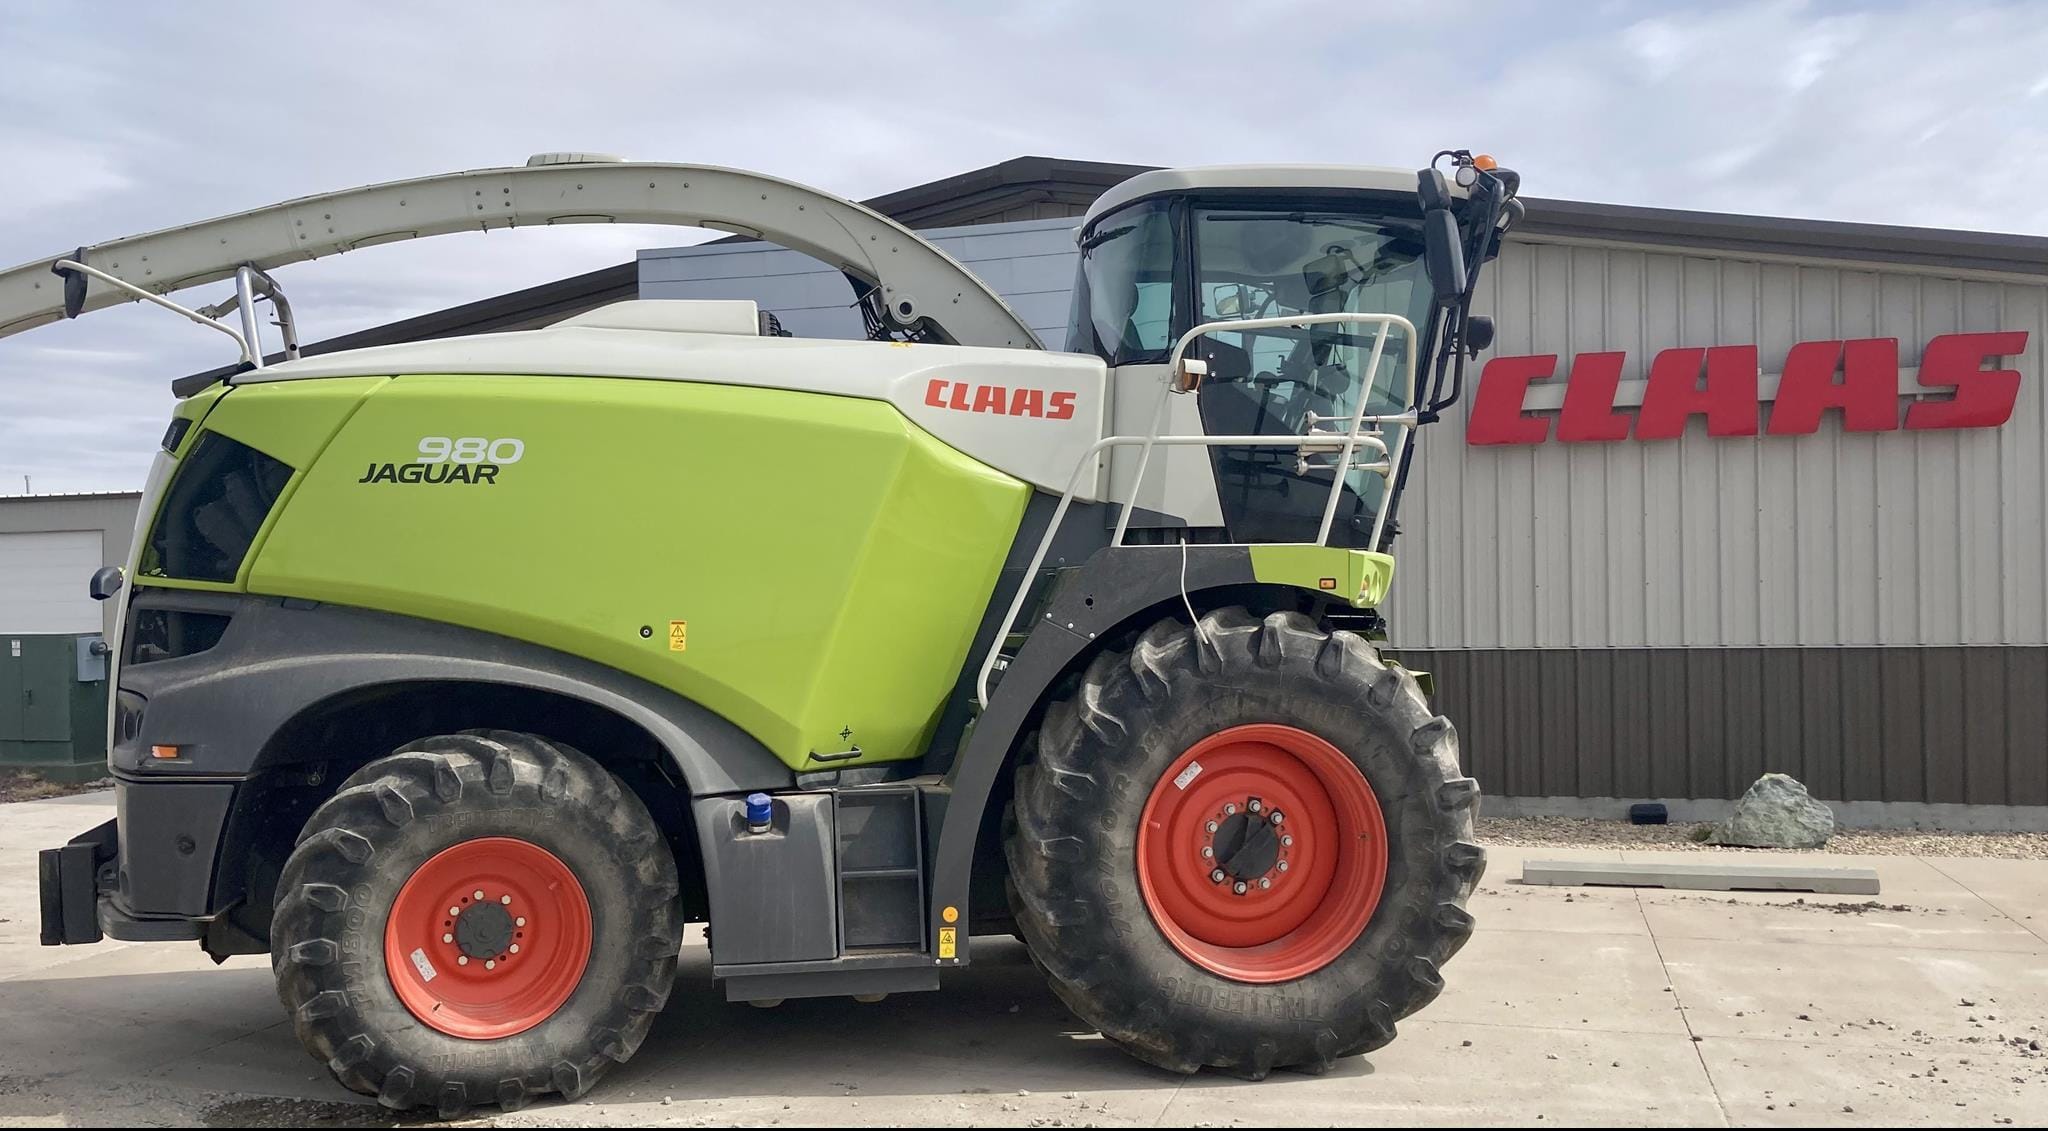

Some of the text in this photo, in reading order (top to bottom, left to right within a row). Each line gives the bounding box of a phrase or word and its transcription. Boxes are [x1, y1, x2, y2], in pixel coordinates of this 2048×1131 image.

[925, 379, 1077, 420] CLAAS
[1466, 331, 2030, 446] CLAAS
[416, 436, 525, 464] 980
[358, 463, 500, 484] JAGUAR
